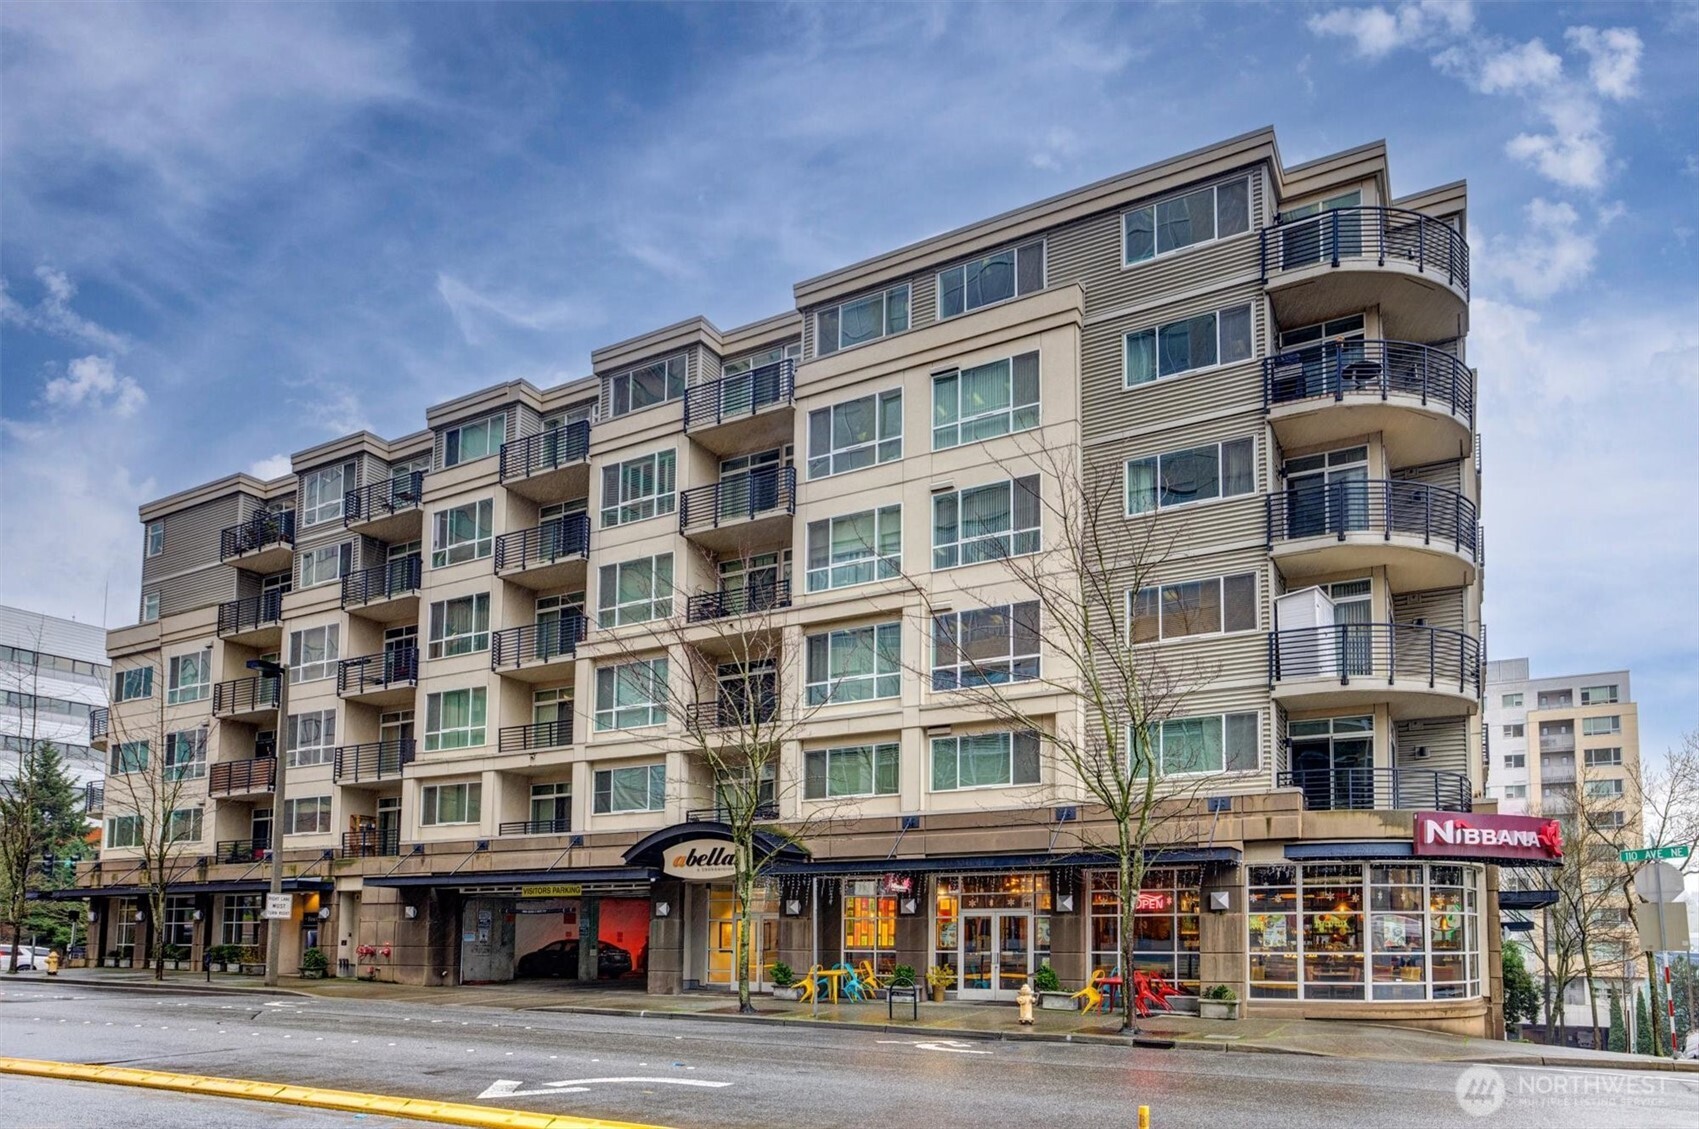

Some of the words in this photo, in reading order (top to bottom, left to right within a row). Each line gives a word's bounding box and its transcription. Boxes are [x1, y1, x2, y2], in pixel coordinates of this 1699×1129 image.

[673, 847, 736, 868] abella
[1625, 851, 1638, 861] 110
[1645, 849, 1663, 859] AVE
[1671, 847, 1684, 857] NE
[523, 886, 551, 895] VISITORS
[552, 886, 580, 894] PARKING
